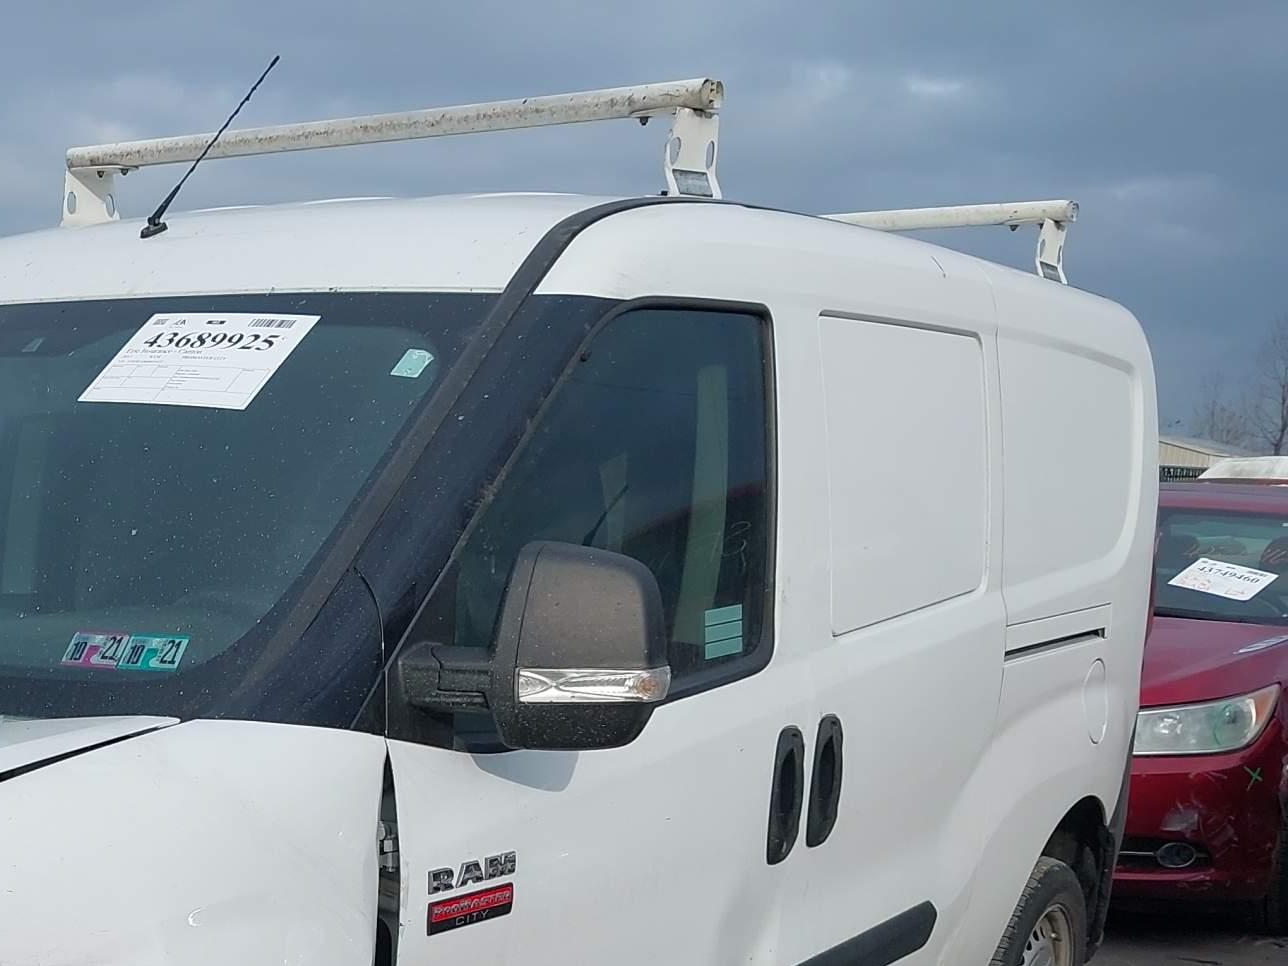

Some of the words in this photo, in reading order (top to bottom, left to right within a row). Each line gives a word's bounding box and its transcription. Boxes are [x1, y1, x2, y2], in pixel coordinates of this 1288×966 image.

[143, 331, 282, 351] 43689925
[70, 641, 88, 661] 10
[100, 635, 124, 661] 21
[126, 644, 145, 665] 10
[158, 639, 182, 665] 21
[427, 850, 516, 895] RAM
[455, 909, 489, 926] CITY
